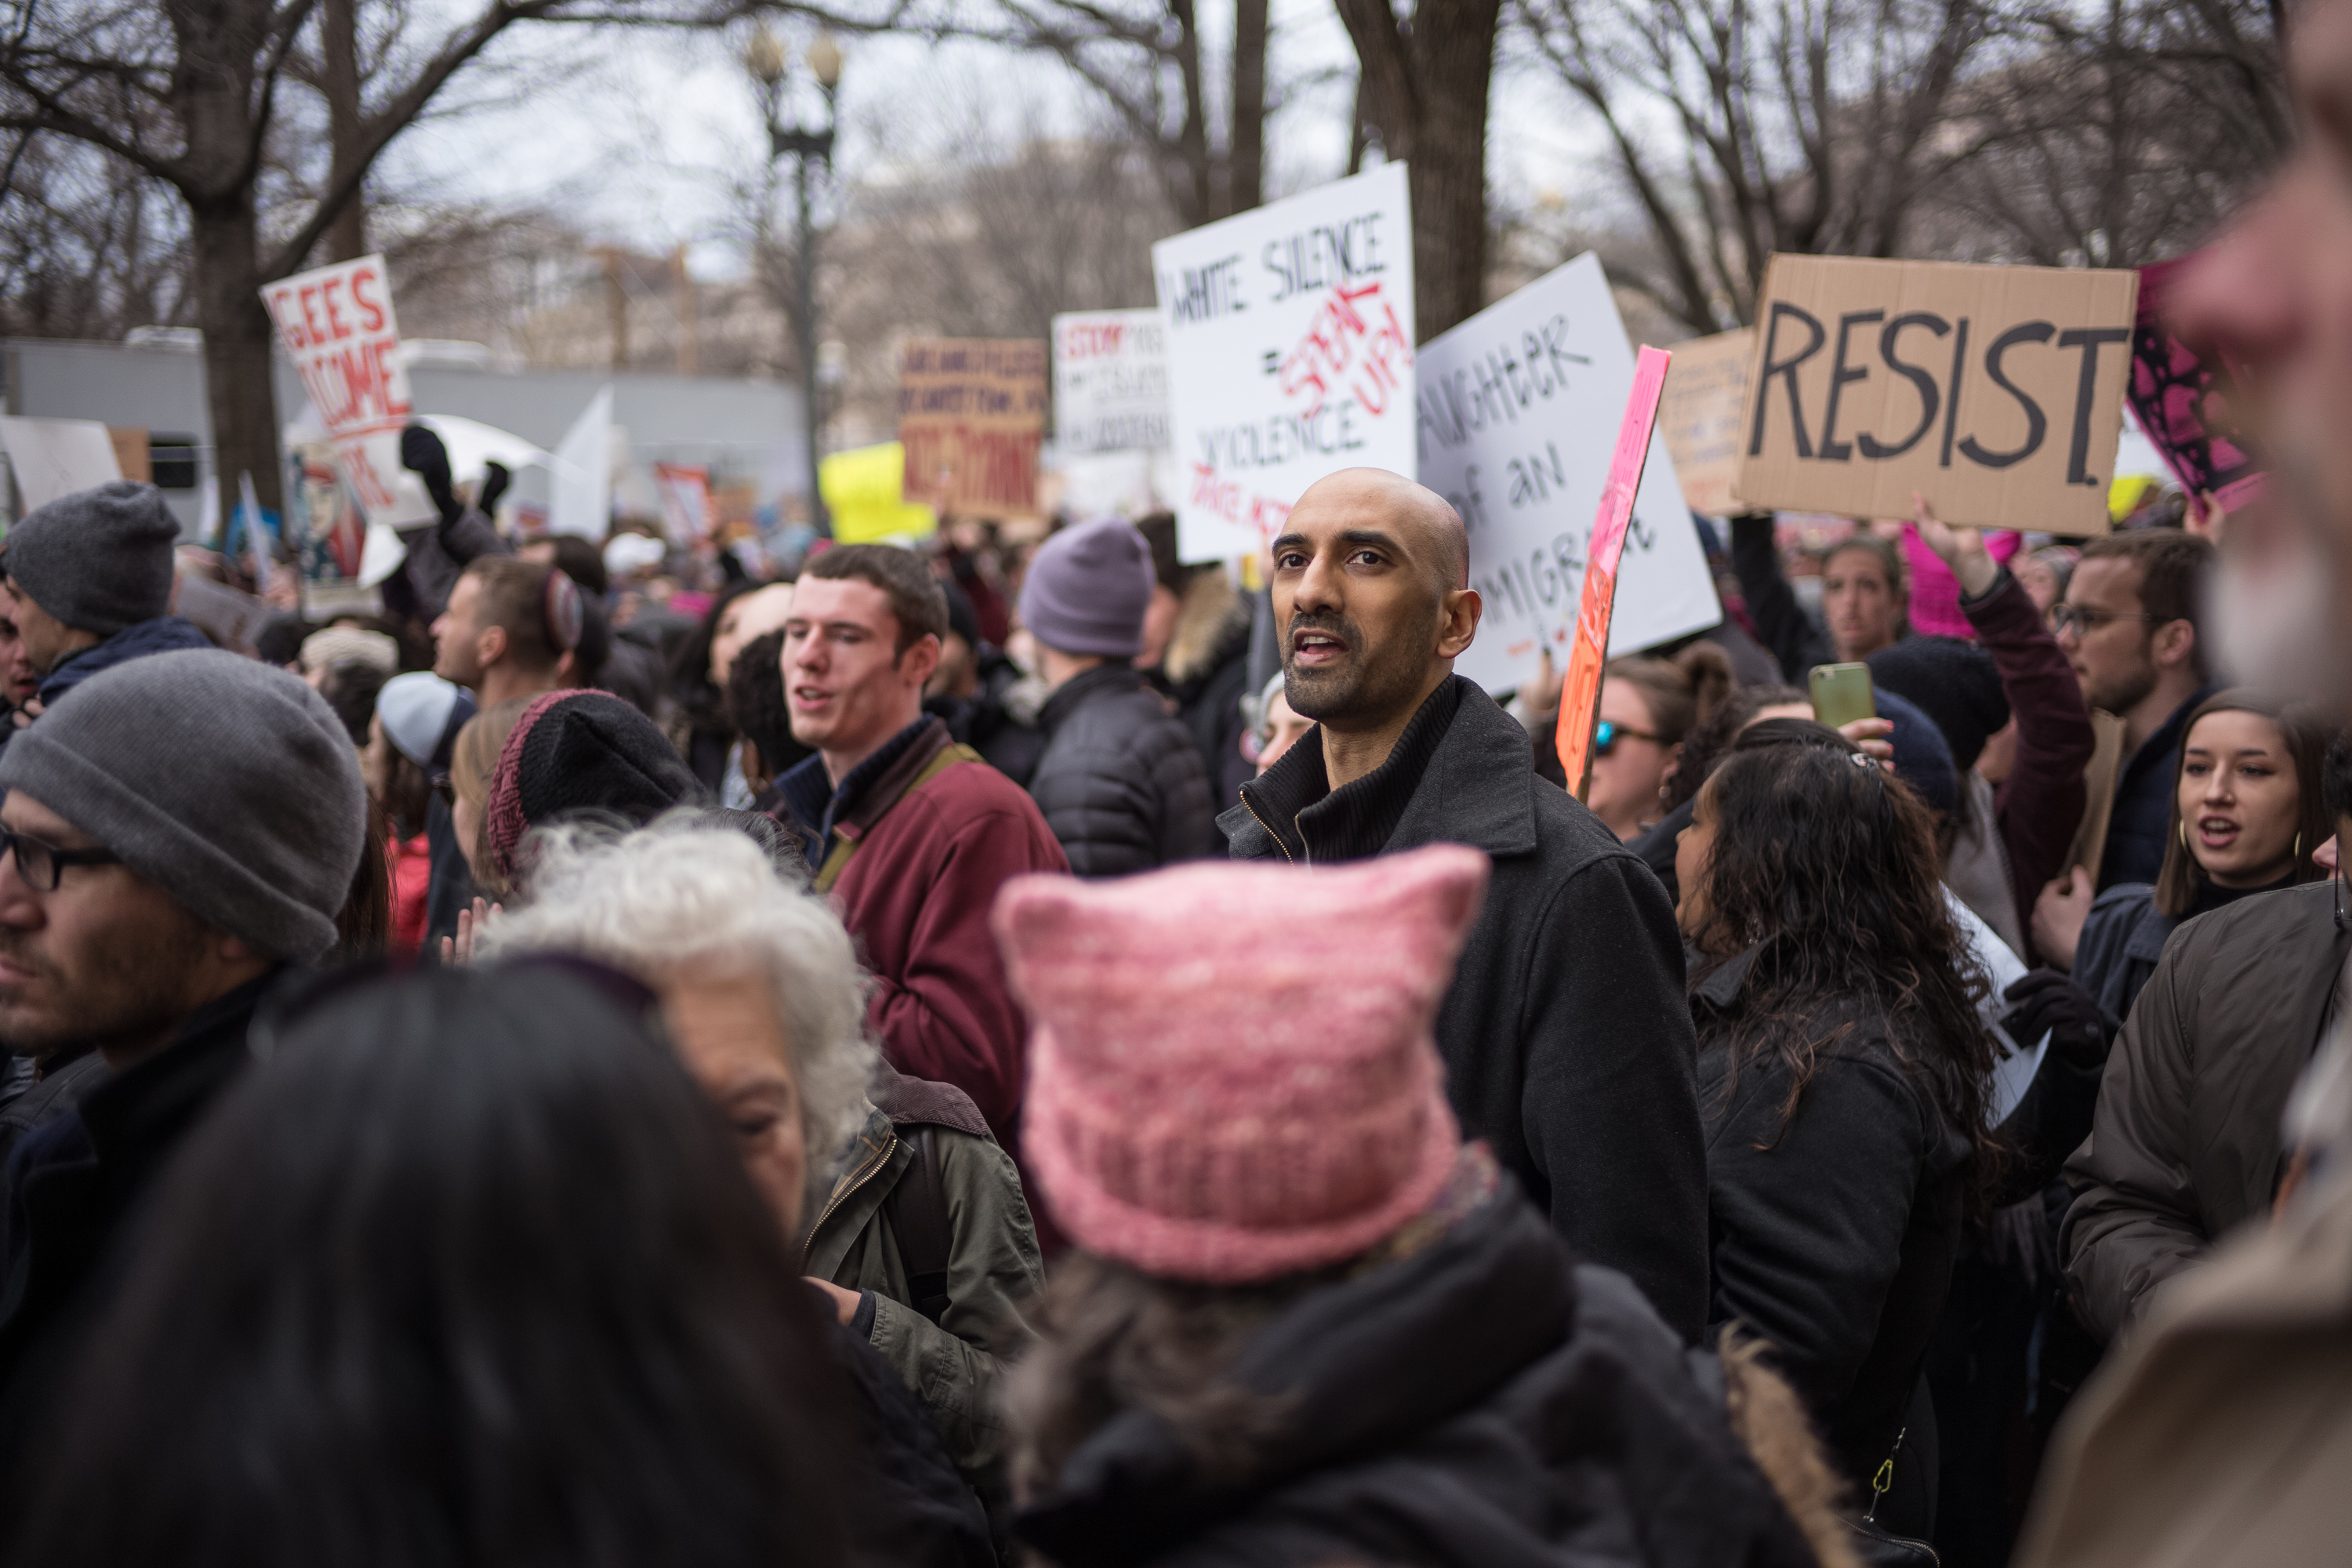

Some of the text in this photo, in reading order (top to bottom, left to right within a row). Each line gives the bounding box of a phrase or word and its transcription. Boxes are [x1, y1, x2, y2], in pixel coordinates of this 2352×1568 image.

[1160, 212, 1387, 324] WHITE SILENCE
[1278, 282, 1381, 420] SPEAK
[1353, 302, 1414, 416] UP!
[1749, 299, 2130, 487] RESIST.
[1197, 399, 1366, 470] VIOLENCE
